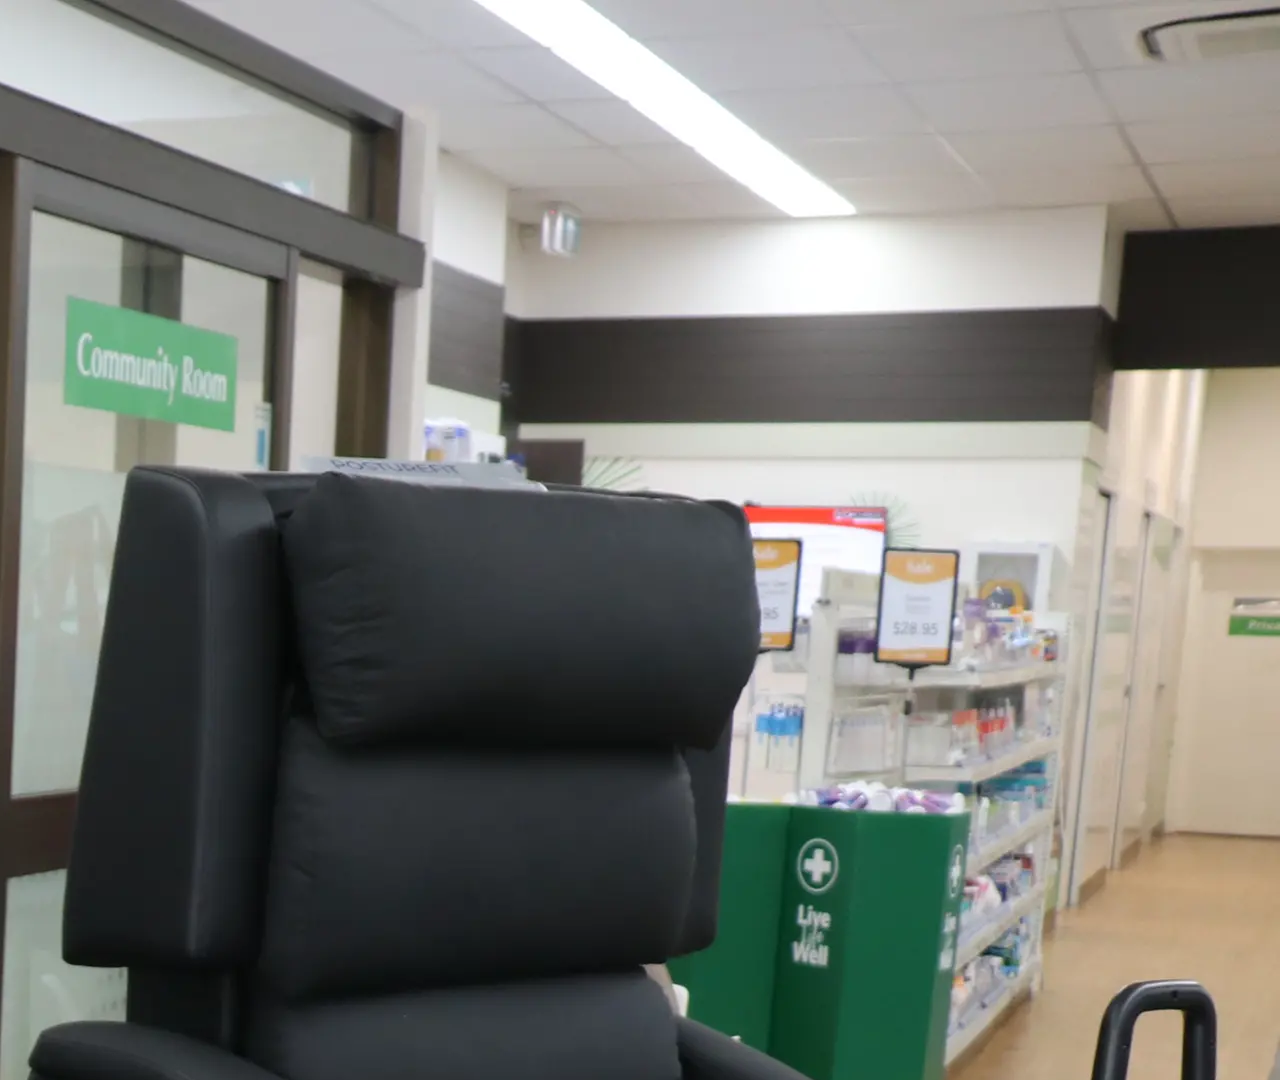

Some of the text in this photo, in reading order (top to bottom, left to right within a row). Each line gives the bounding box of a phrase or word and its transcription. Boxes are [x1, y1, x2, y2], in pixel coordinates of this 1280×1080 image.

[76, 332, 228, 406] Community Room
[796, 904, 832, 929] Live
[792, 941, 830, 968] Well
